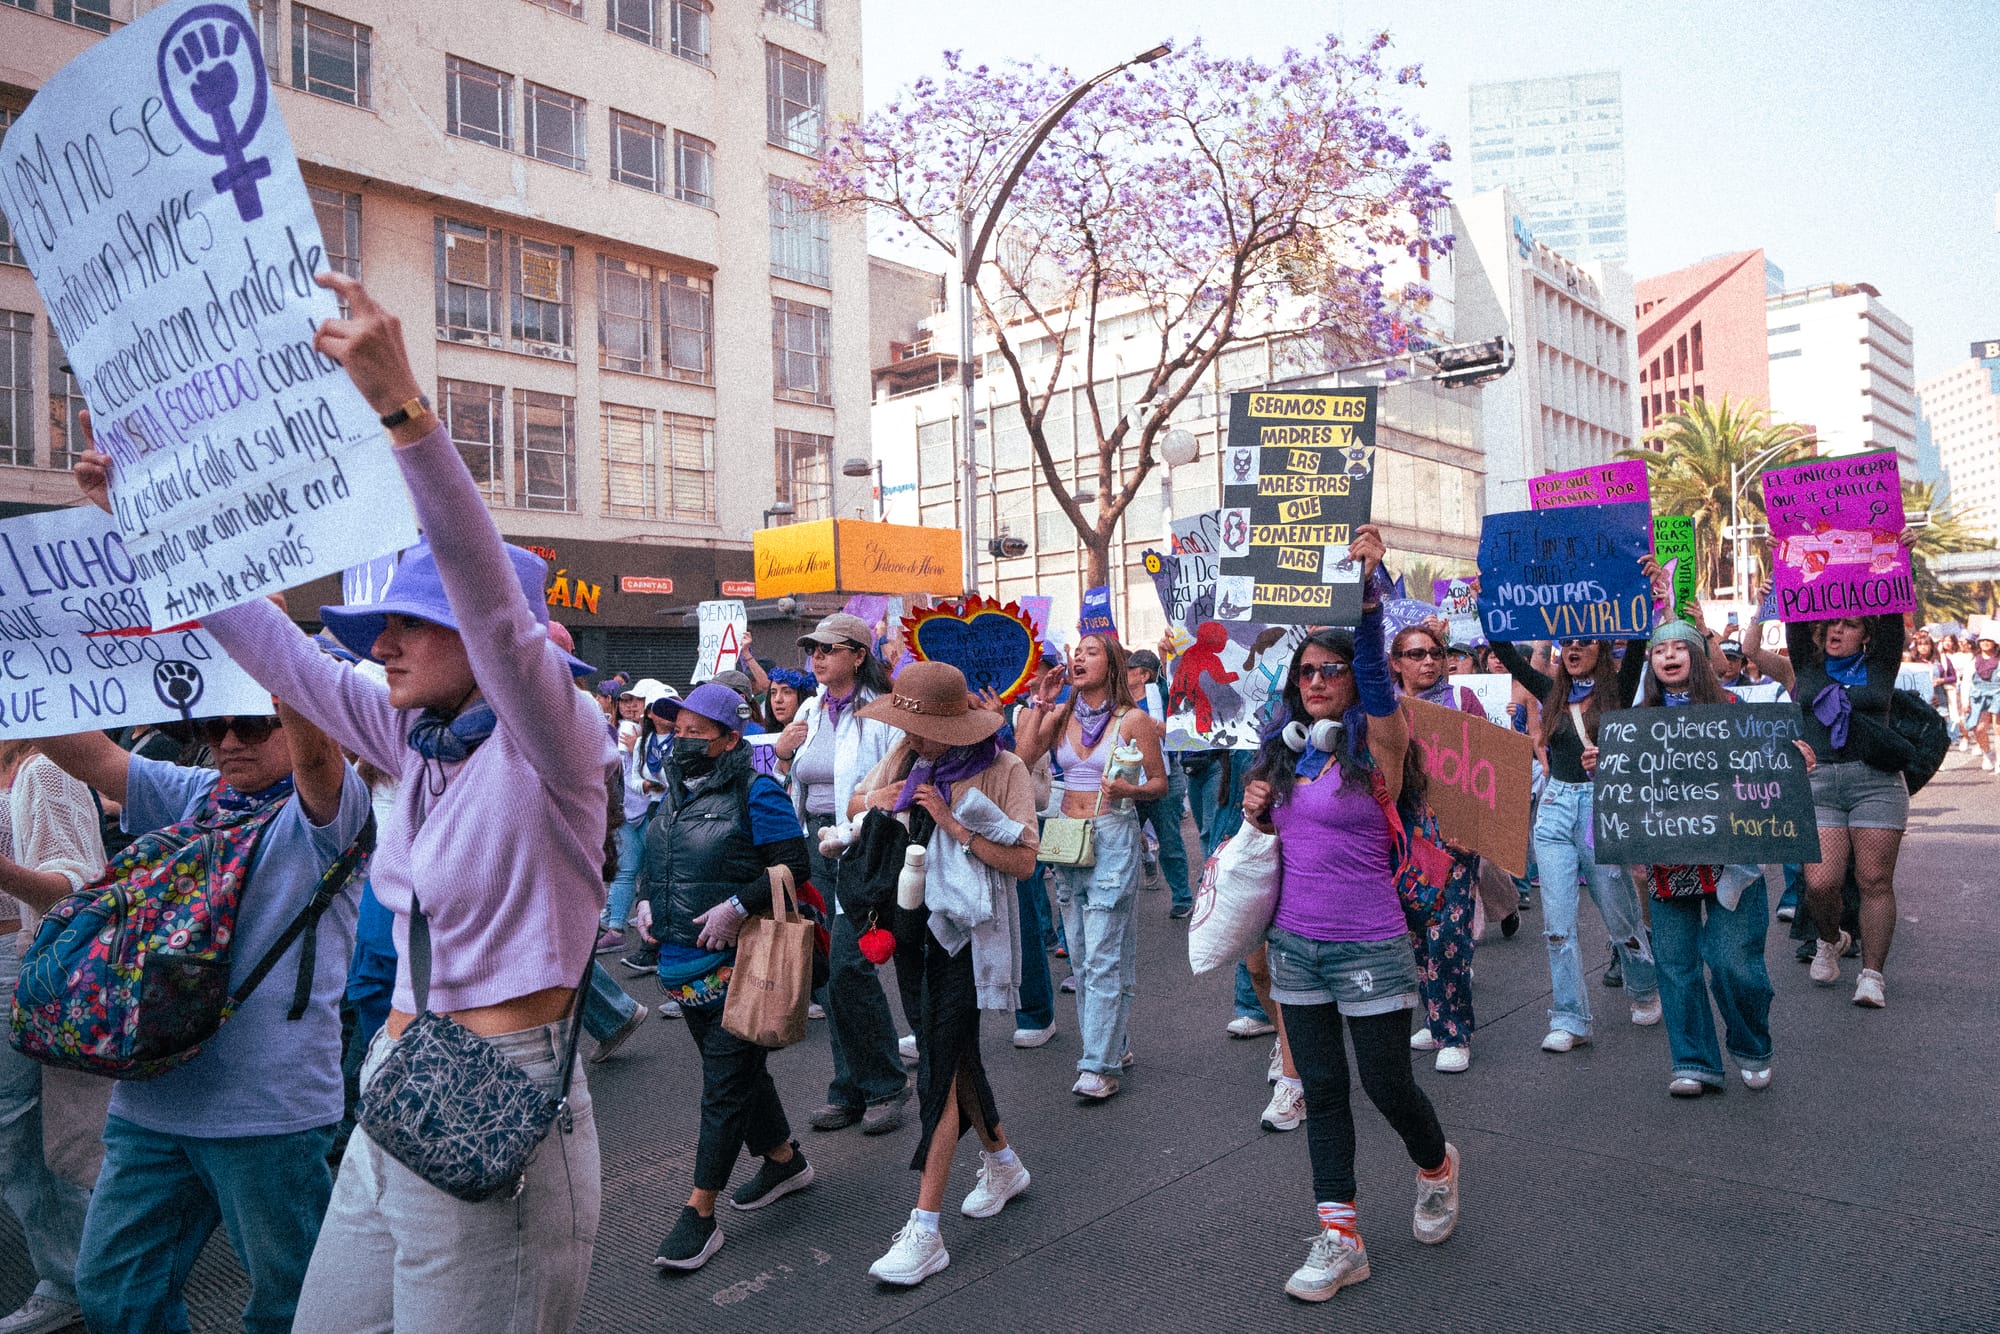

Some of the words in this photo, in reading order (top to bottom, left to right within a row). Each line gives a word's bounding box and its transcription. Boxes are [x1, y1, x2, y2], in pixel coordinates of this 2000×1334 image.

[63, 133, 114, 215] no
[109, 96, 182, 178] se
[83, 242, 131, 316] con
[117, 189, 214, 289] flores
[93, 320, 172, 411] recuerda
[159, 306, 213, 373] con
[203, 269, 237, 352] el
[229, 236, 285, 353] grito
[285, 225, 321, 298] de
[155, 357, 259, 444] ESCOBEDO
[1333, 400, 1365, 418] LAS
[1261, 426, 1332, 446] MADRES
[1341, 427, 1352, 444] Y
[1288, 451, 1319, 471] LAS
[1766, 474, 1787, 488] EL
[1846, 459, 1898, 478] CUERPO
[112, 491, 135, 537] la
[134, 470, 183, 538] justicia
[174, 451, 200, 501] le
[236, 436, 258, 472] a
[254, 425, 286, 465] su
[1259, 475, 1349, 494] MAESTRAS
[1600, 470, 1617, 483] TE
[1287, 496, 1320, 518] QUE
[1536, 490, 1600, 510] ESPANTAS
[1606, 482, 1636, 498] POR
[1772, 494, 1798, 508] QUE
[1805, 490, 1819, 503] SE
[1826, 480, 1889, 499] CRITICA
[132, 555, 154, 582] un
[152, 530, 186, 587] grito
[186, 521, 214, 569] que
[244, 481, 298, 527] duele
[303, 478, 333, 511] en
[330, 456, 351, 500] el
[1783, 512, 1806, 523] ES
[1821, 501, 1846, 515] EL
[1250, 525, 1348, 543] FOMENTEN
[1, 530, 138, 597] LUCHO
[525, 543, 557, 561] ERÍA
[1655, 544, 1690, 555] PARA
[164, 580, 218, 622] ALMA
[217, 569, 238, 602] de
[240, 554, 270, 592] este
[268, 522, 315, 583] país
[627, 581, 667, 590] CARNITAS
[547, 568, 601, 614] ÁN
[1254, 586, 1331, 605] ALIADOS!
[1498, 580, 1607, 607] NOSOTRAS
[1487, 609, 1519, 633] DE
[1540, 593, 1648, 636] VIVIRLO
[0, 649, 29, 680] e
[31, 641, 73, 676] lo
[86, 633, 165, 669] debo
[177, 629, 212, 661] a
[68, 676, 127, 720] NO
[1603, 721, 1637, 742] me
[1651, 716, 1730, 749] quieres
[1599, 754, 1631, 775] me
[1638, 748, 1718, 784] quieres
[1729, 747, 1792, 773] santa
[1599, 783, 1634, 804] me
[1640, 778, 1720, 813] quieres
[1732, 774, 1782, 810] tuya
[1600, 812, 1630, 840] Me
[1641, 811, 1719, 837] tienes
[1729, 812, 1798, 838] harta
